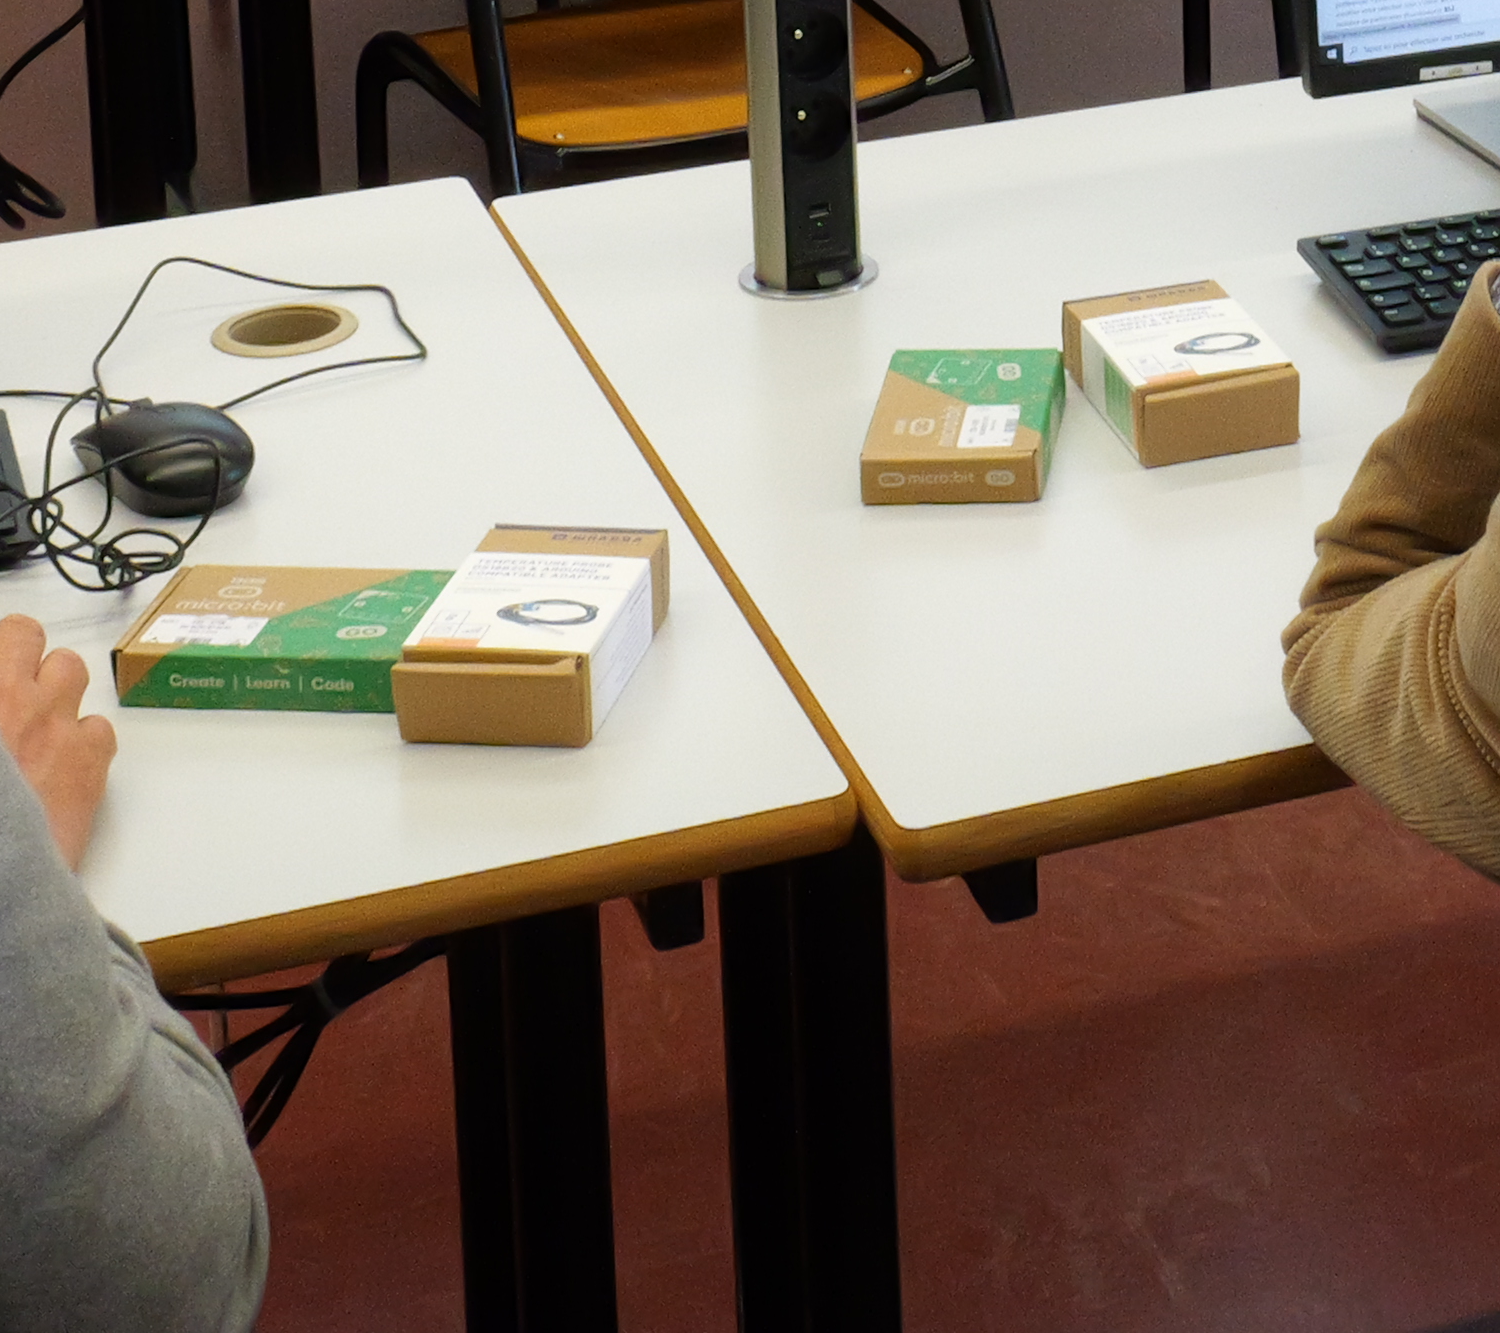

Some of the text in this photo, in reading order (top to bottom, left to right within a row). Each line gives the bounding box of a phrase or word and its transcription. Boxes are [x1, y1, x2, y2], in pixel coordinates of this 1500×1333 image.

[908, 470, 974, 484] micro:bit
[477, 558, 614, 569] TEMPERATURE PROBE
[468, 570, 612, 581] COMPATIBLE ADAPTER
[175, 598, 286, 613] micro:bit
[345, 626, 379, 638] GO
[169, 674, 354, 691] Create Learn Code
